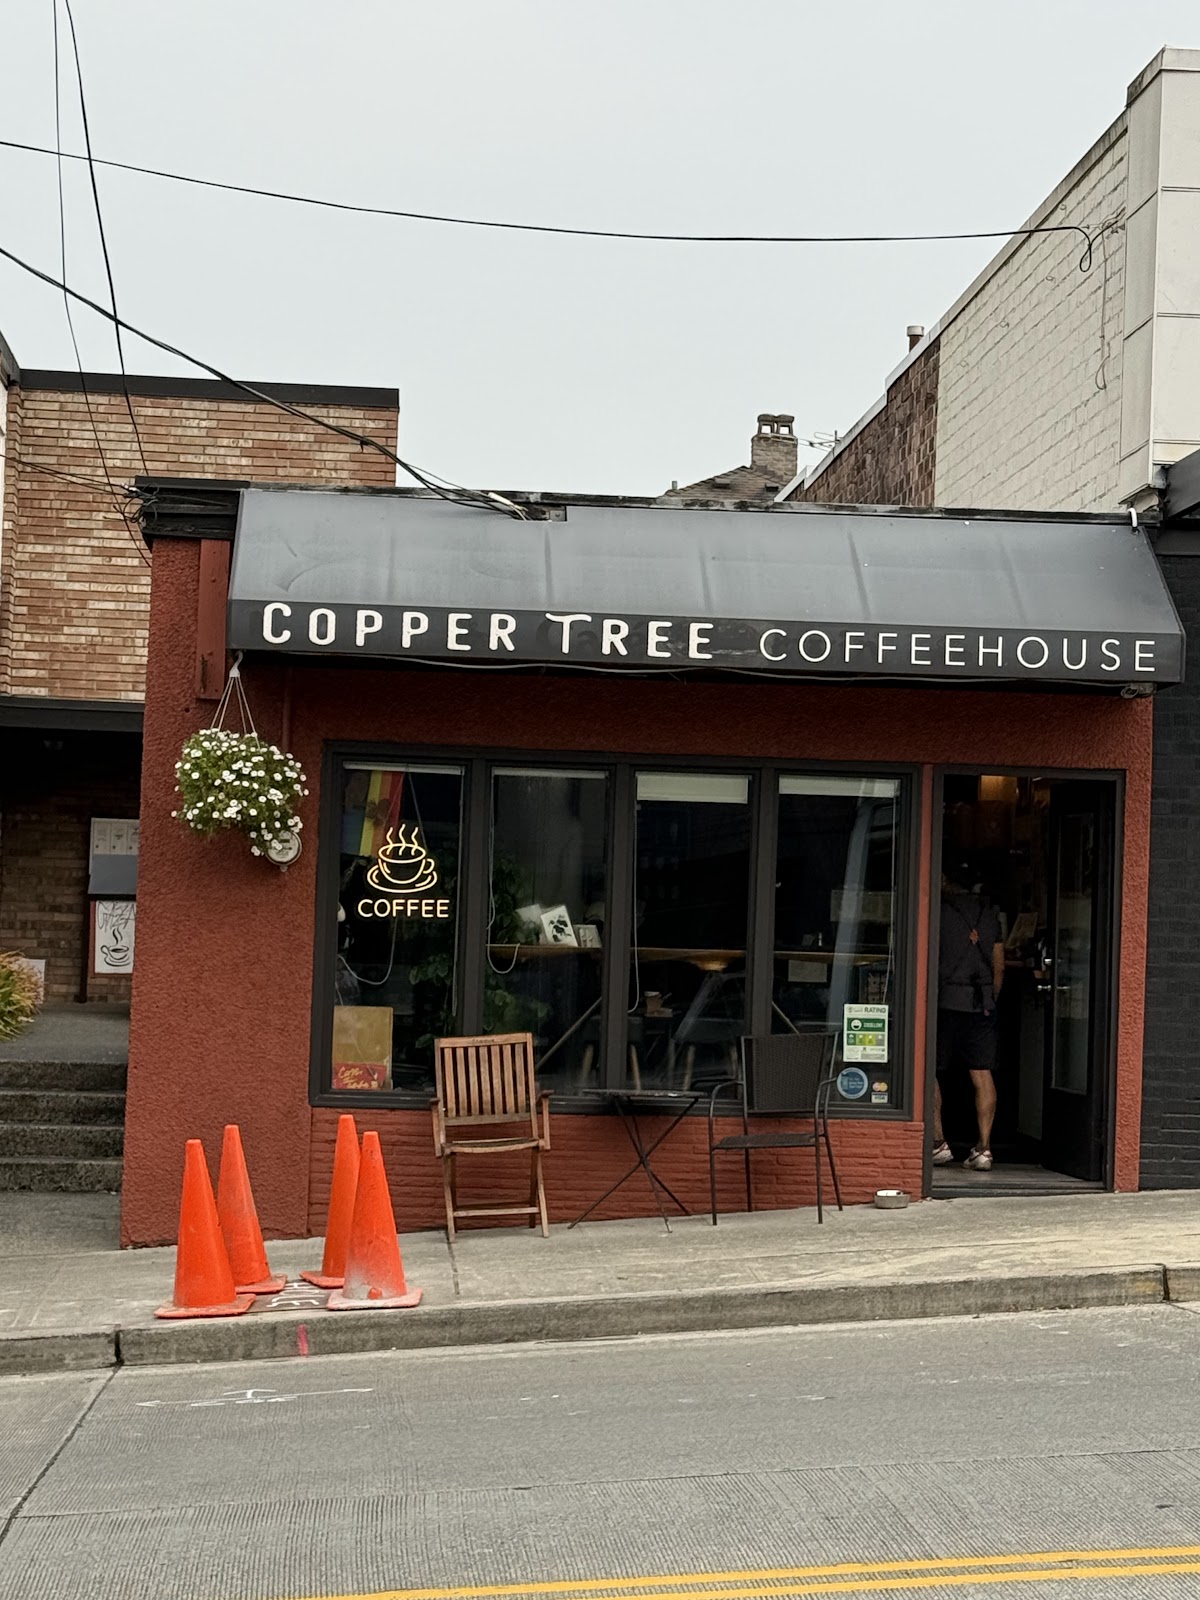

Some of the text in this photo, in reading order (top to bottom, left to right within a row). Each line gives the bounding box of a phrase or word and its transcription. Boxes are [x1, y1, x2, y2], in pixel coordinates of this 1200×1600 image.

[262, 602, 1156, 673] COPPER TREE COFFEEHOUSE
[357, 898, 450, 918] COFFEE
